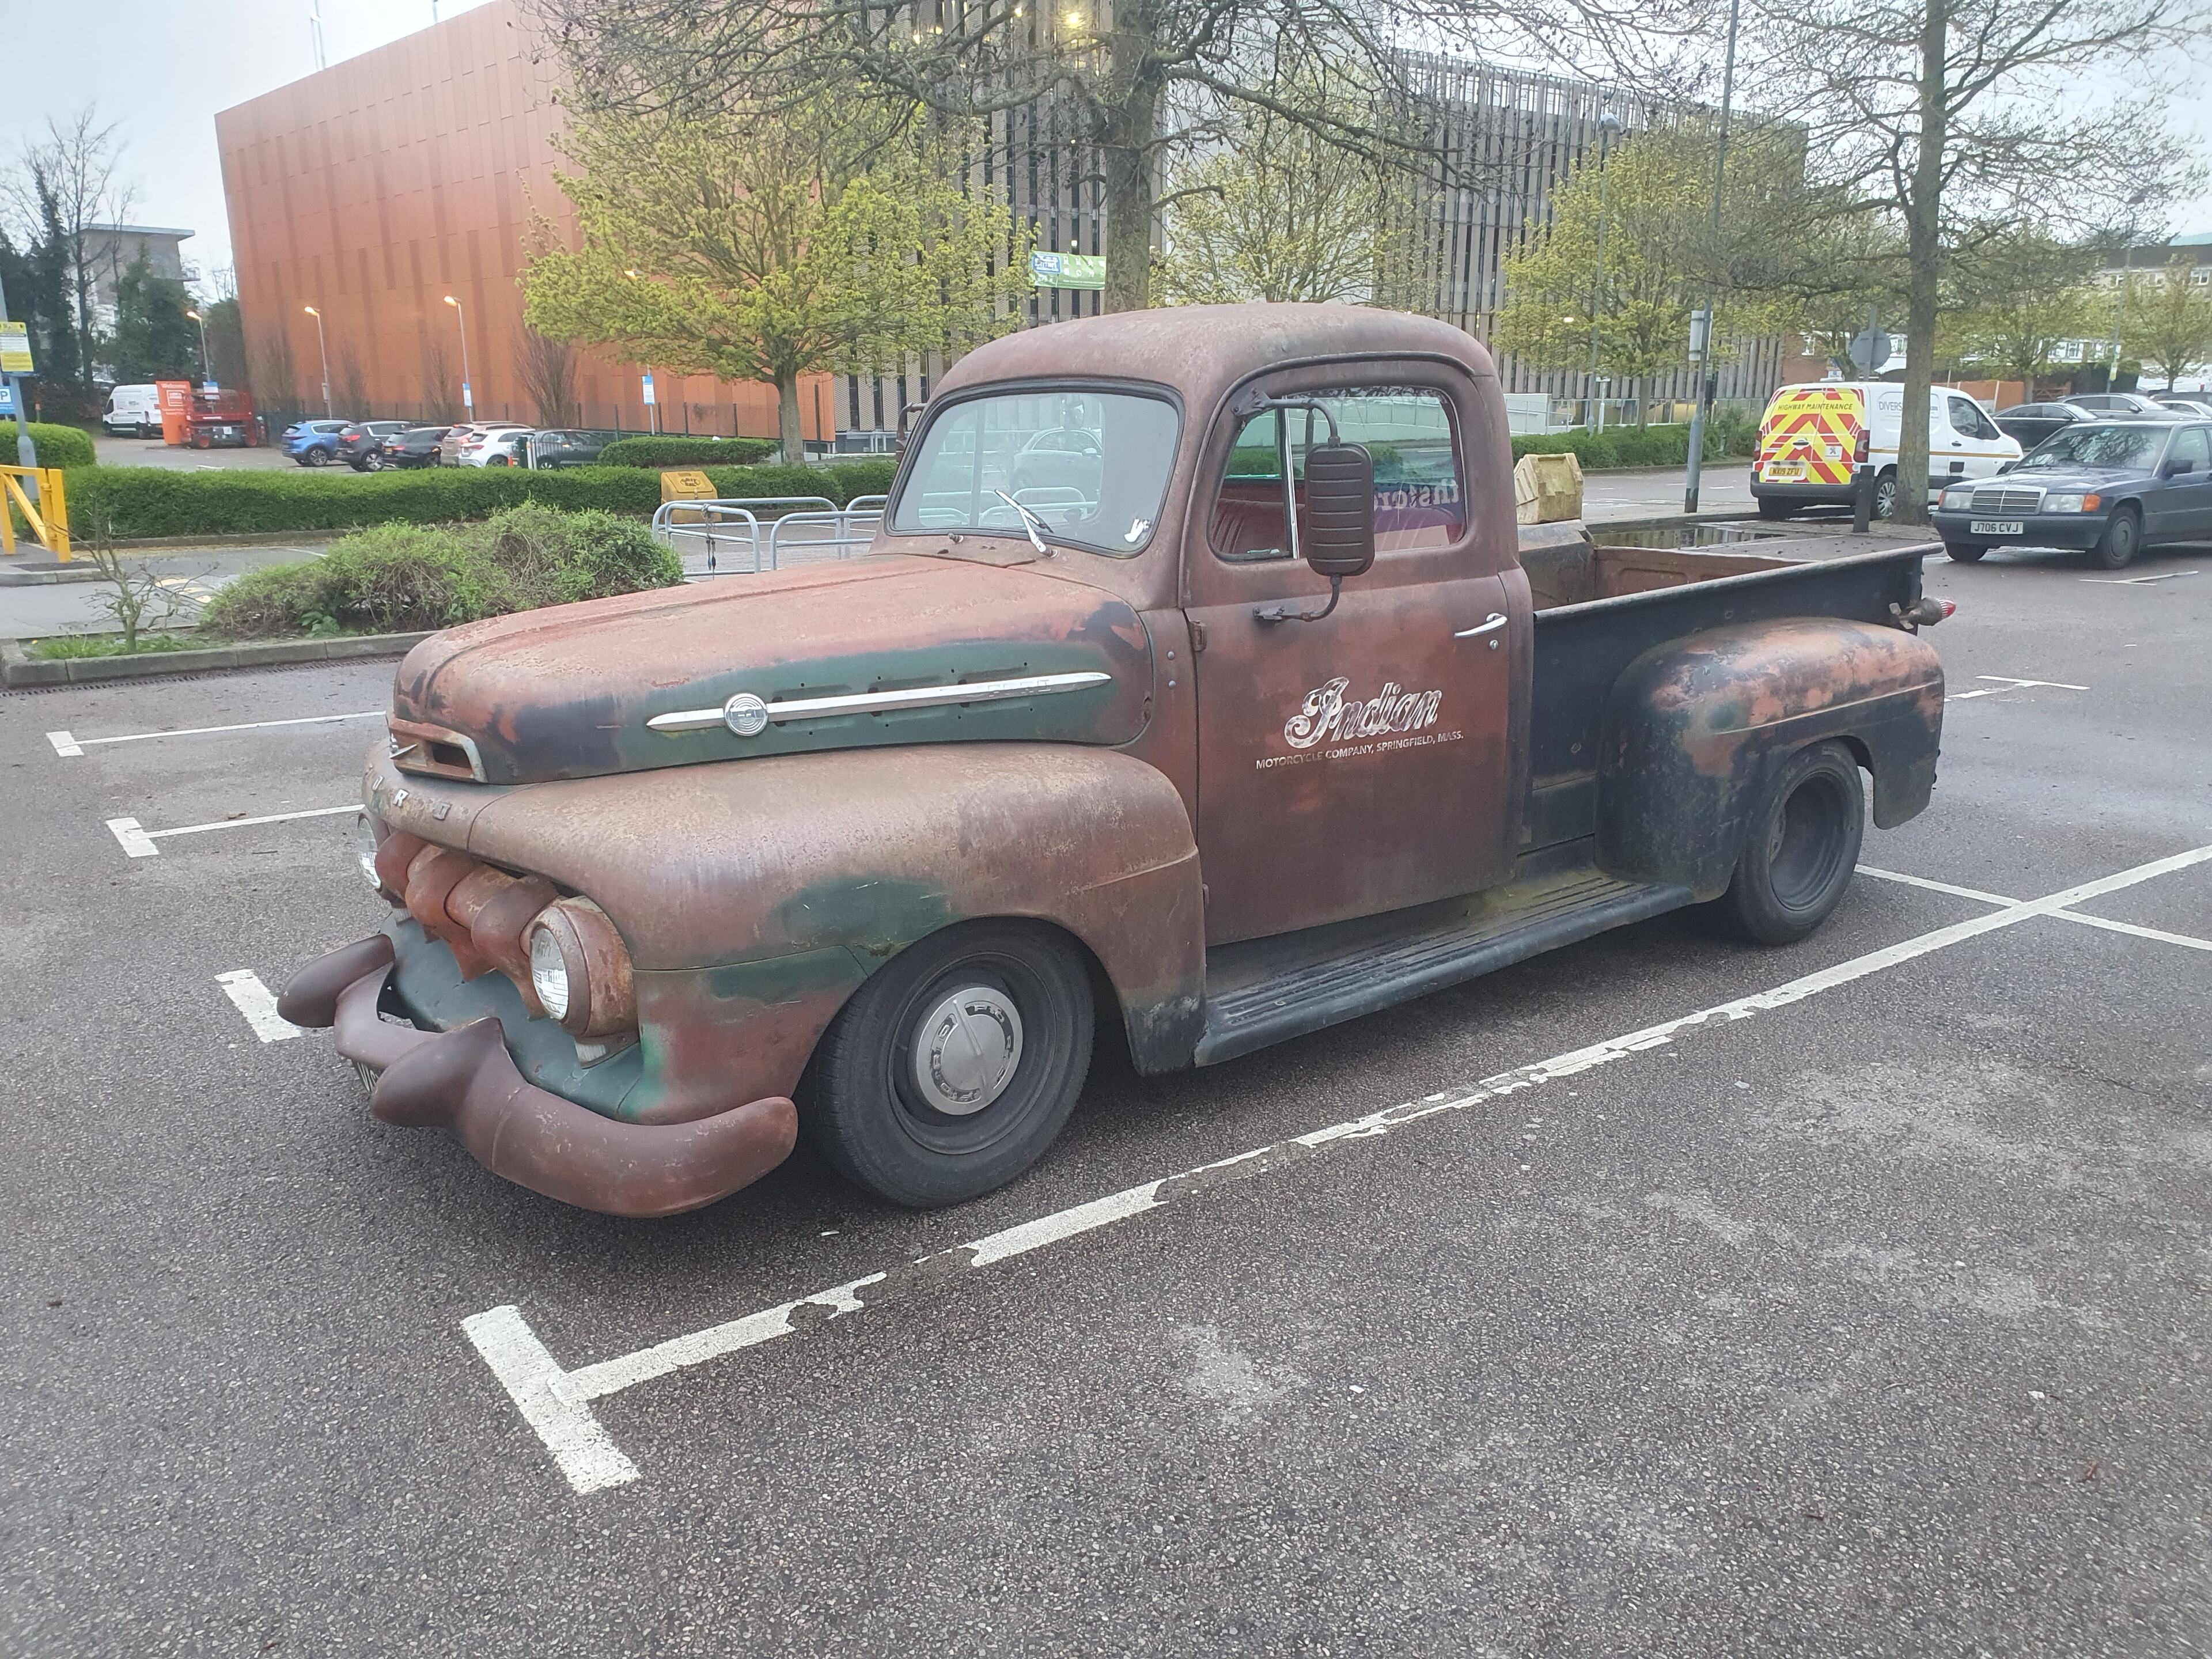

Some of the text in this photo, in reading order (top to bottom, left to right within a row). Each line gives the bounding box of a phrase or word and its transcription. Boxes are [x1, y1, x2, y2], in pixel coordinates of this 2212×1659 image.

[1975, 523, 2019, 532] J706 CVJ
[1284, 676, 1442, 748] Indian
[1256, 730, 1464, 770] MOTORCYCLE COMPANY, SPRINGFIELD, MASS.
